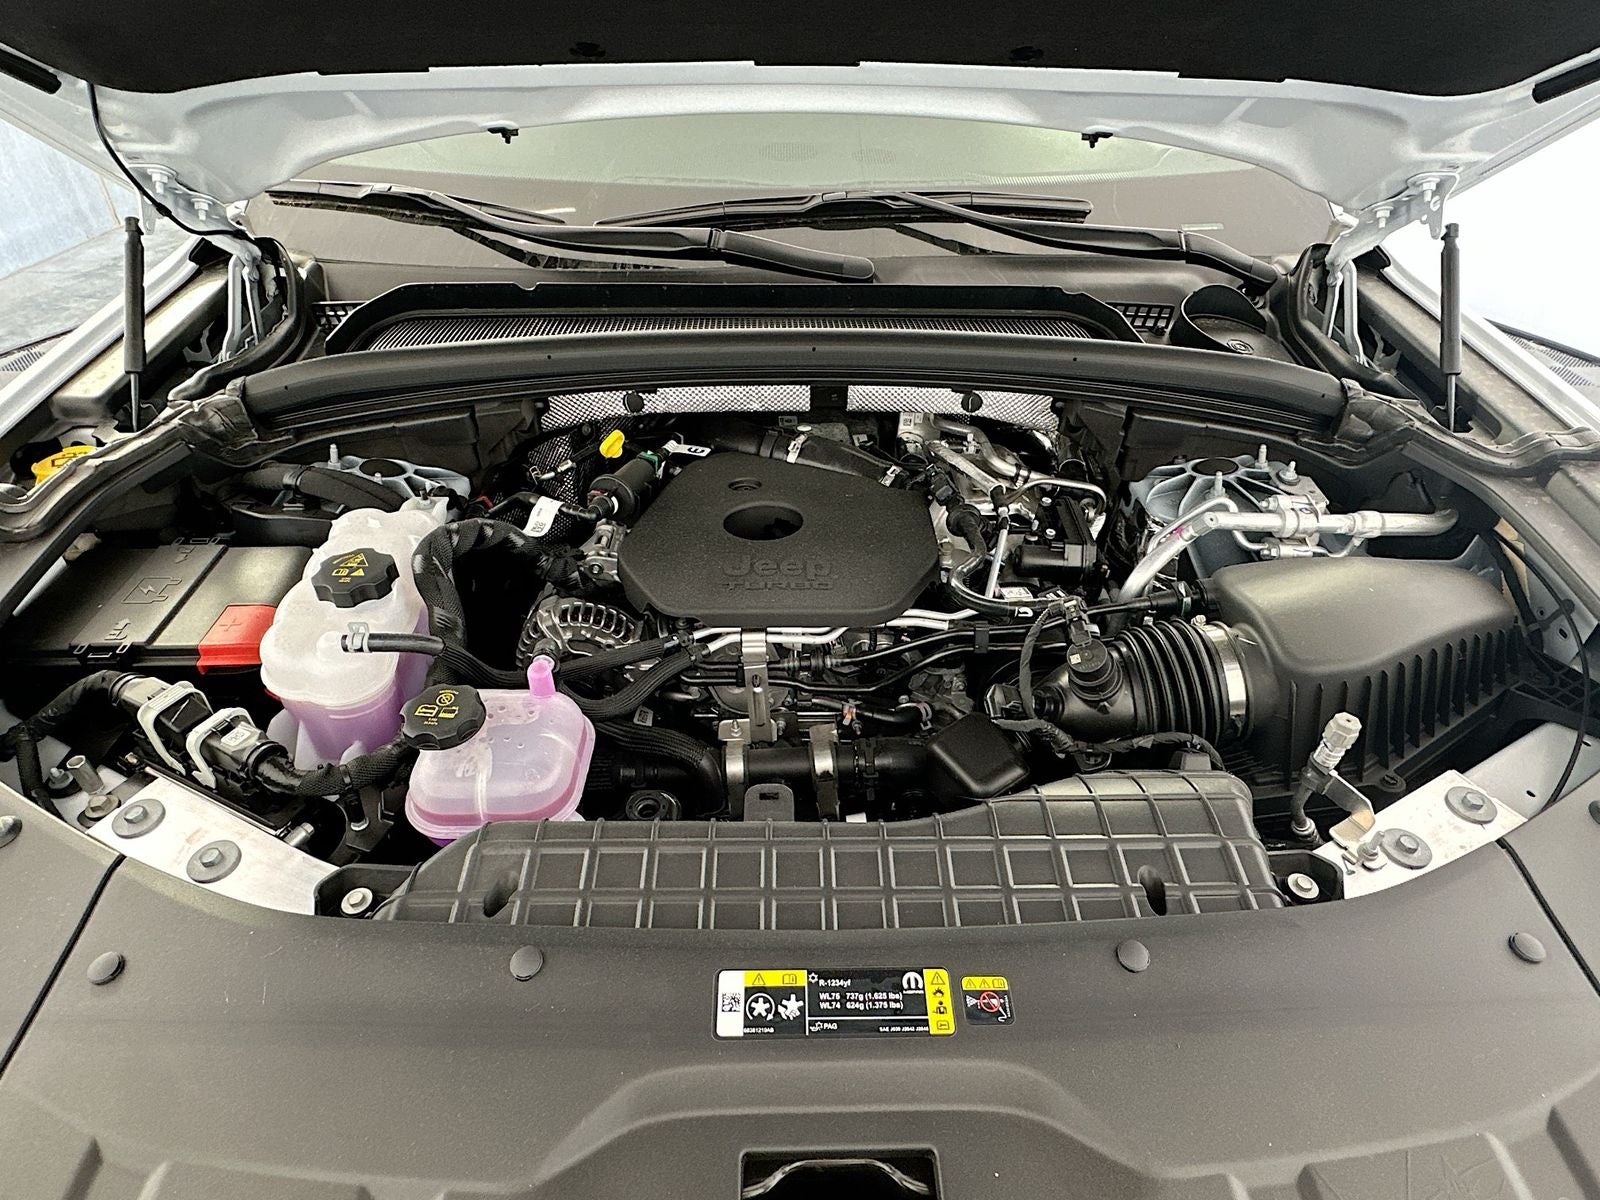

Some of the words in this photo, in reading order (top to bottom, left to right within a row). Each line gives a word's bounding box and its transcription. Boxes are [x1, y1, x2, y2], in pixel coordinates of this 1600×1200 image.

[722, 553, 832, 581] Jeep
[721, 581, 834, 591] TURBO
[818, 978, 851, 988] R-1234yf
[819, 992, 841, 1001] WL75
[845, 992, 864, 1001] 737g
[865, 991, 887, 1001] (1.625
[819, 1001, 841, 1009] WL74
[846, 1001, 865, 1010] 624g
[865, 1001, 888, 1010] (1.375
[823, 1022, 838, 1030] PAG
